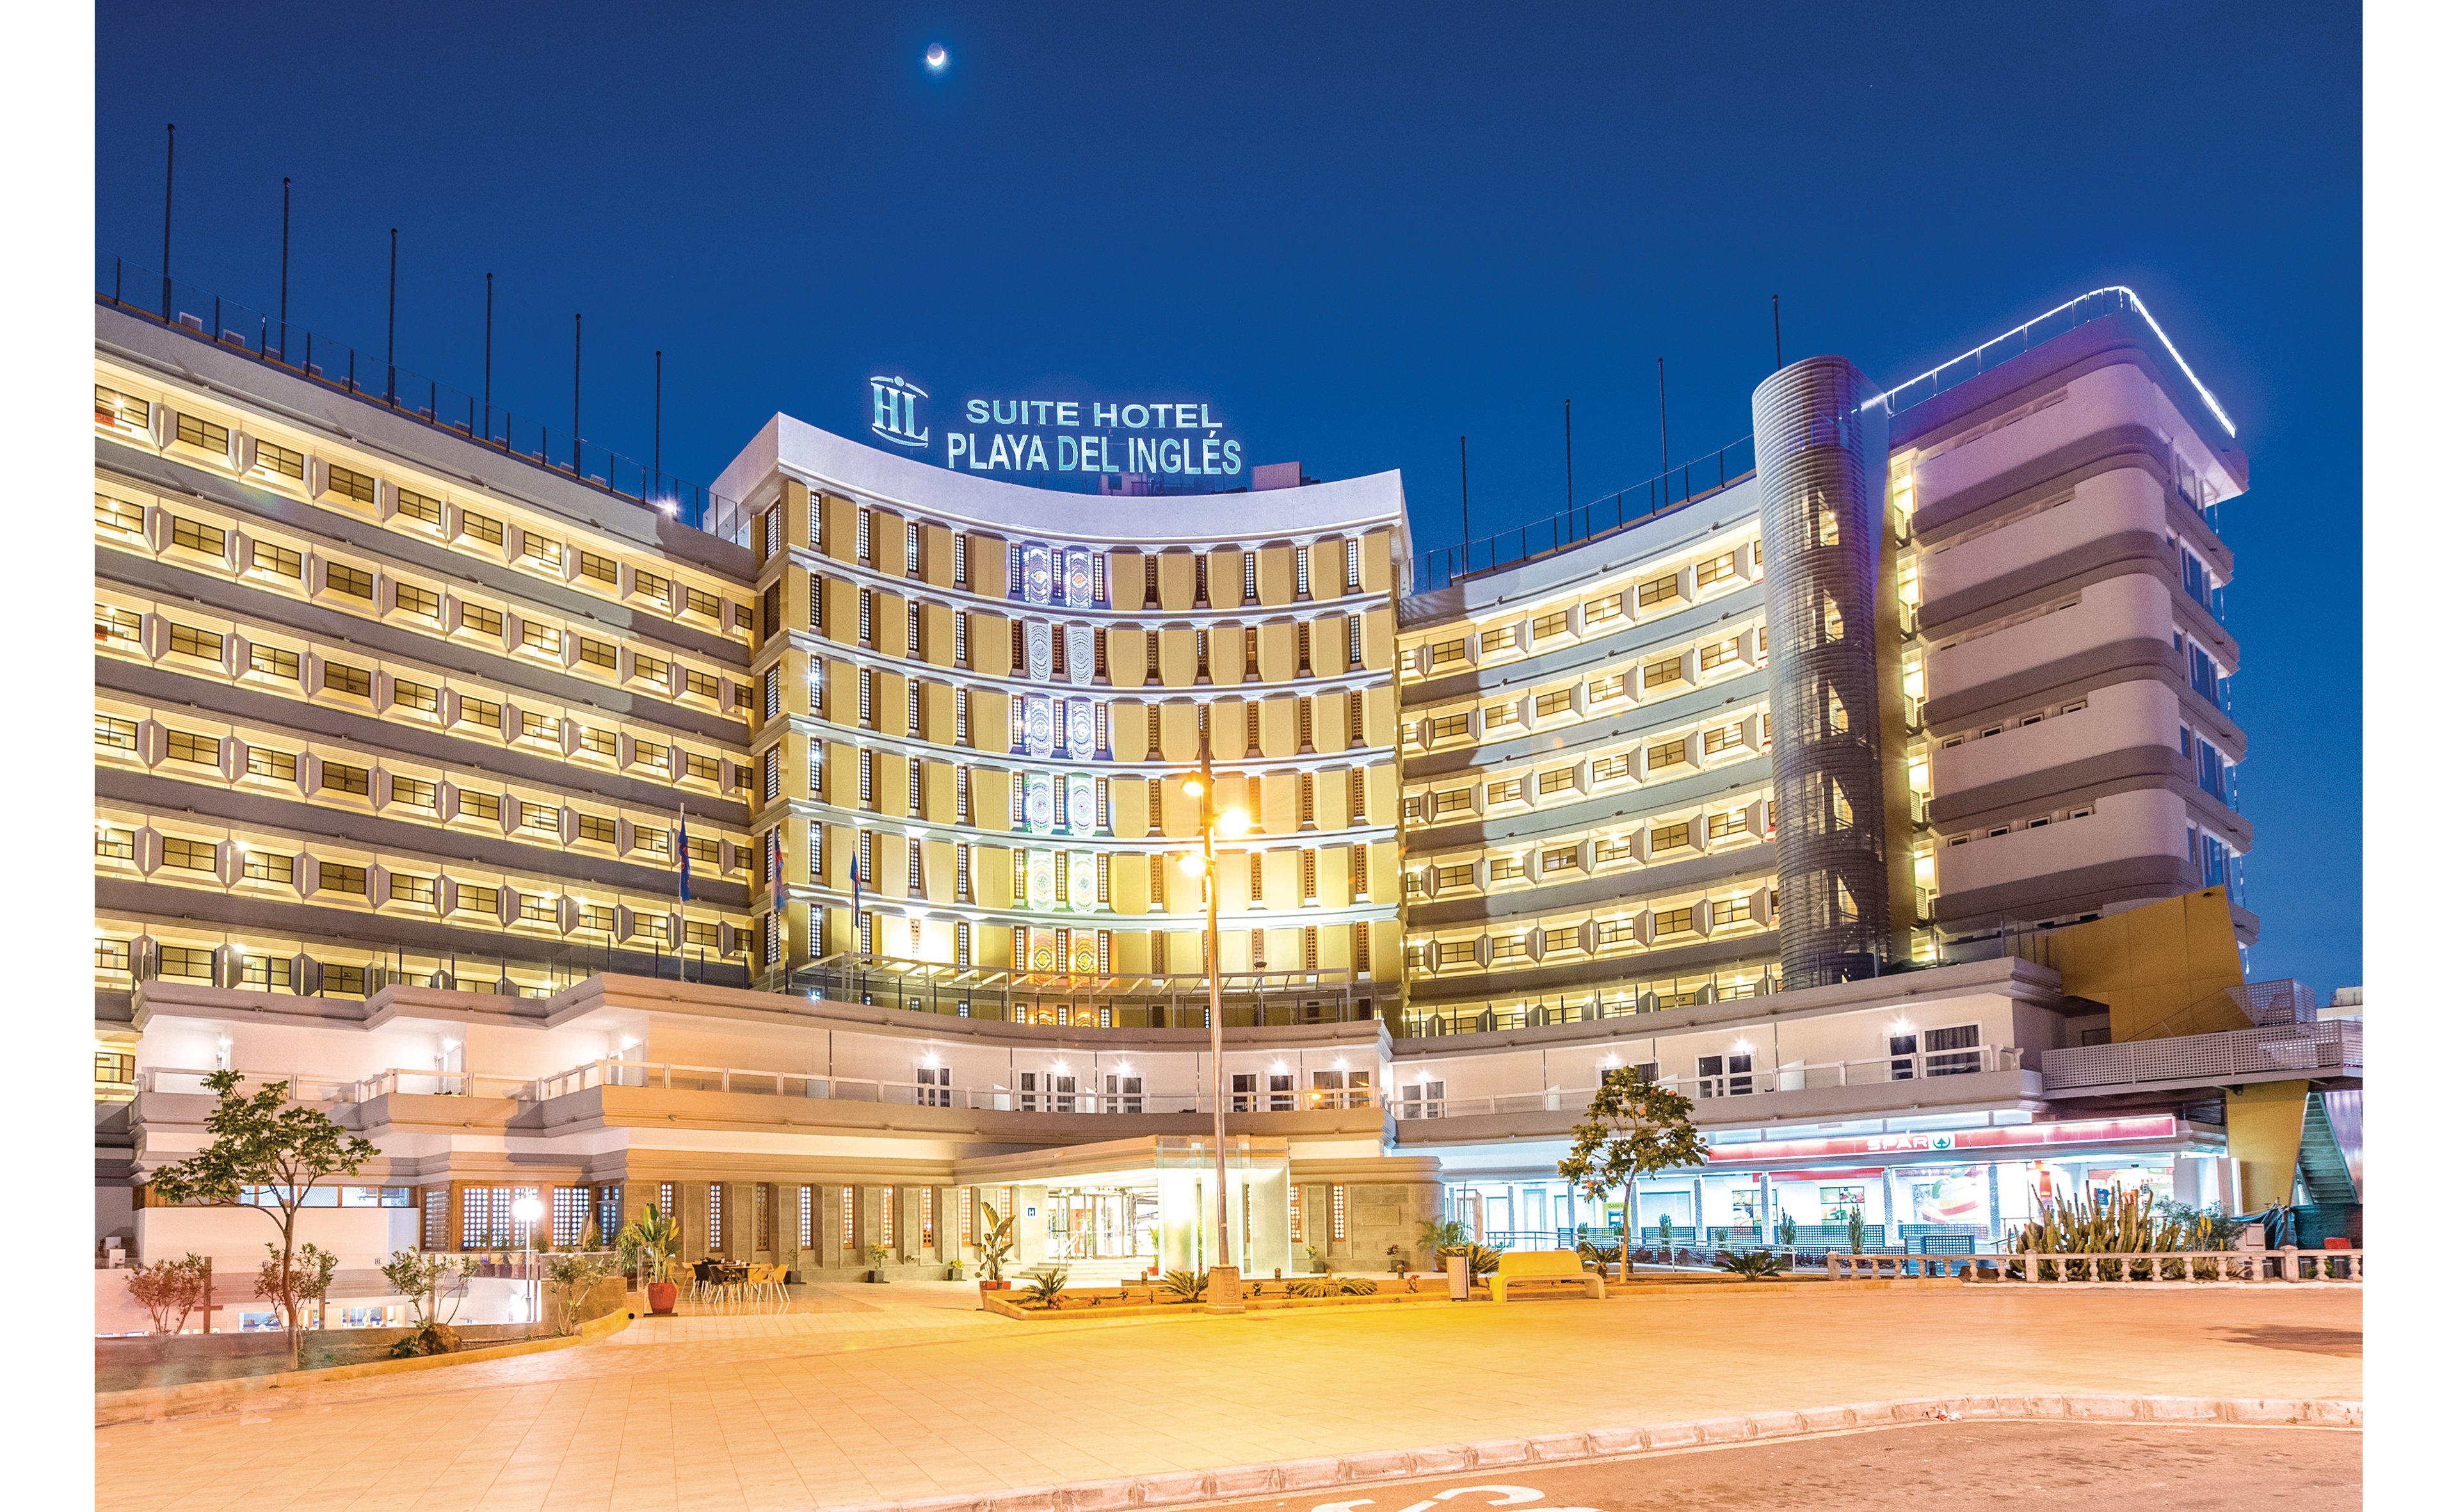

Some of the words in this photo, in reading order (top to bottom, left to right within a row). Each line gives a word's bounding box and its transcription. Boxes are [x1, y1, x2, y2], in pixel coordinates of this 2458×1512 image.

[966, 399, 1080, 426] SUITE
[1093, 403, 1223, 428] HOTEL
[947, 433, 1049, 470] PLAYA
[1058, 435, 1120, 472] DEL
[1129, 430, 1241, 475] INGLÉS
[1867, 1136, 1927, 1150] SPAR
